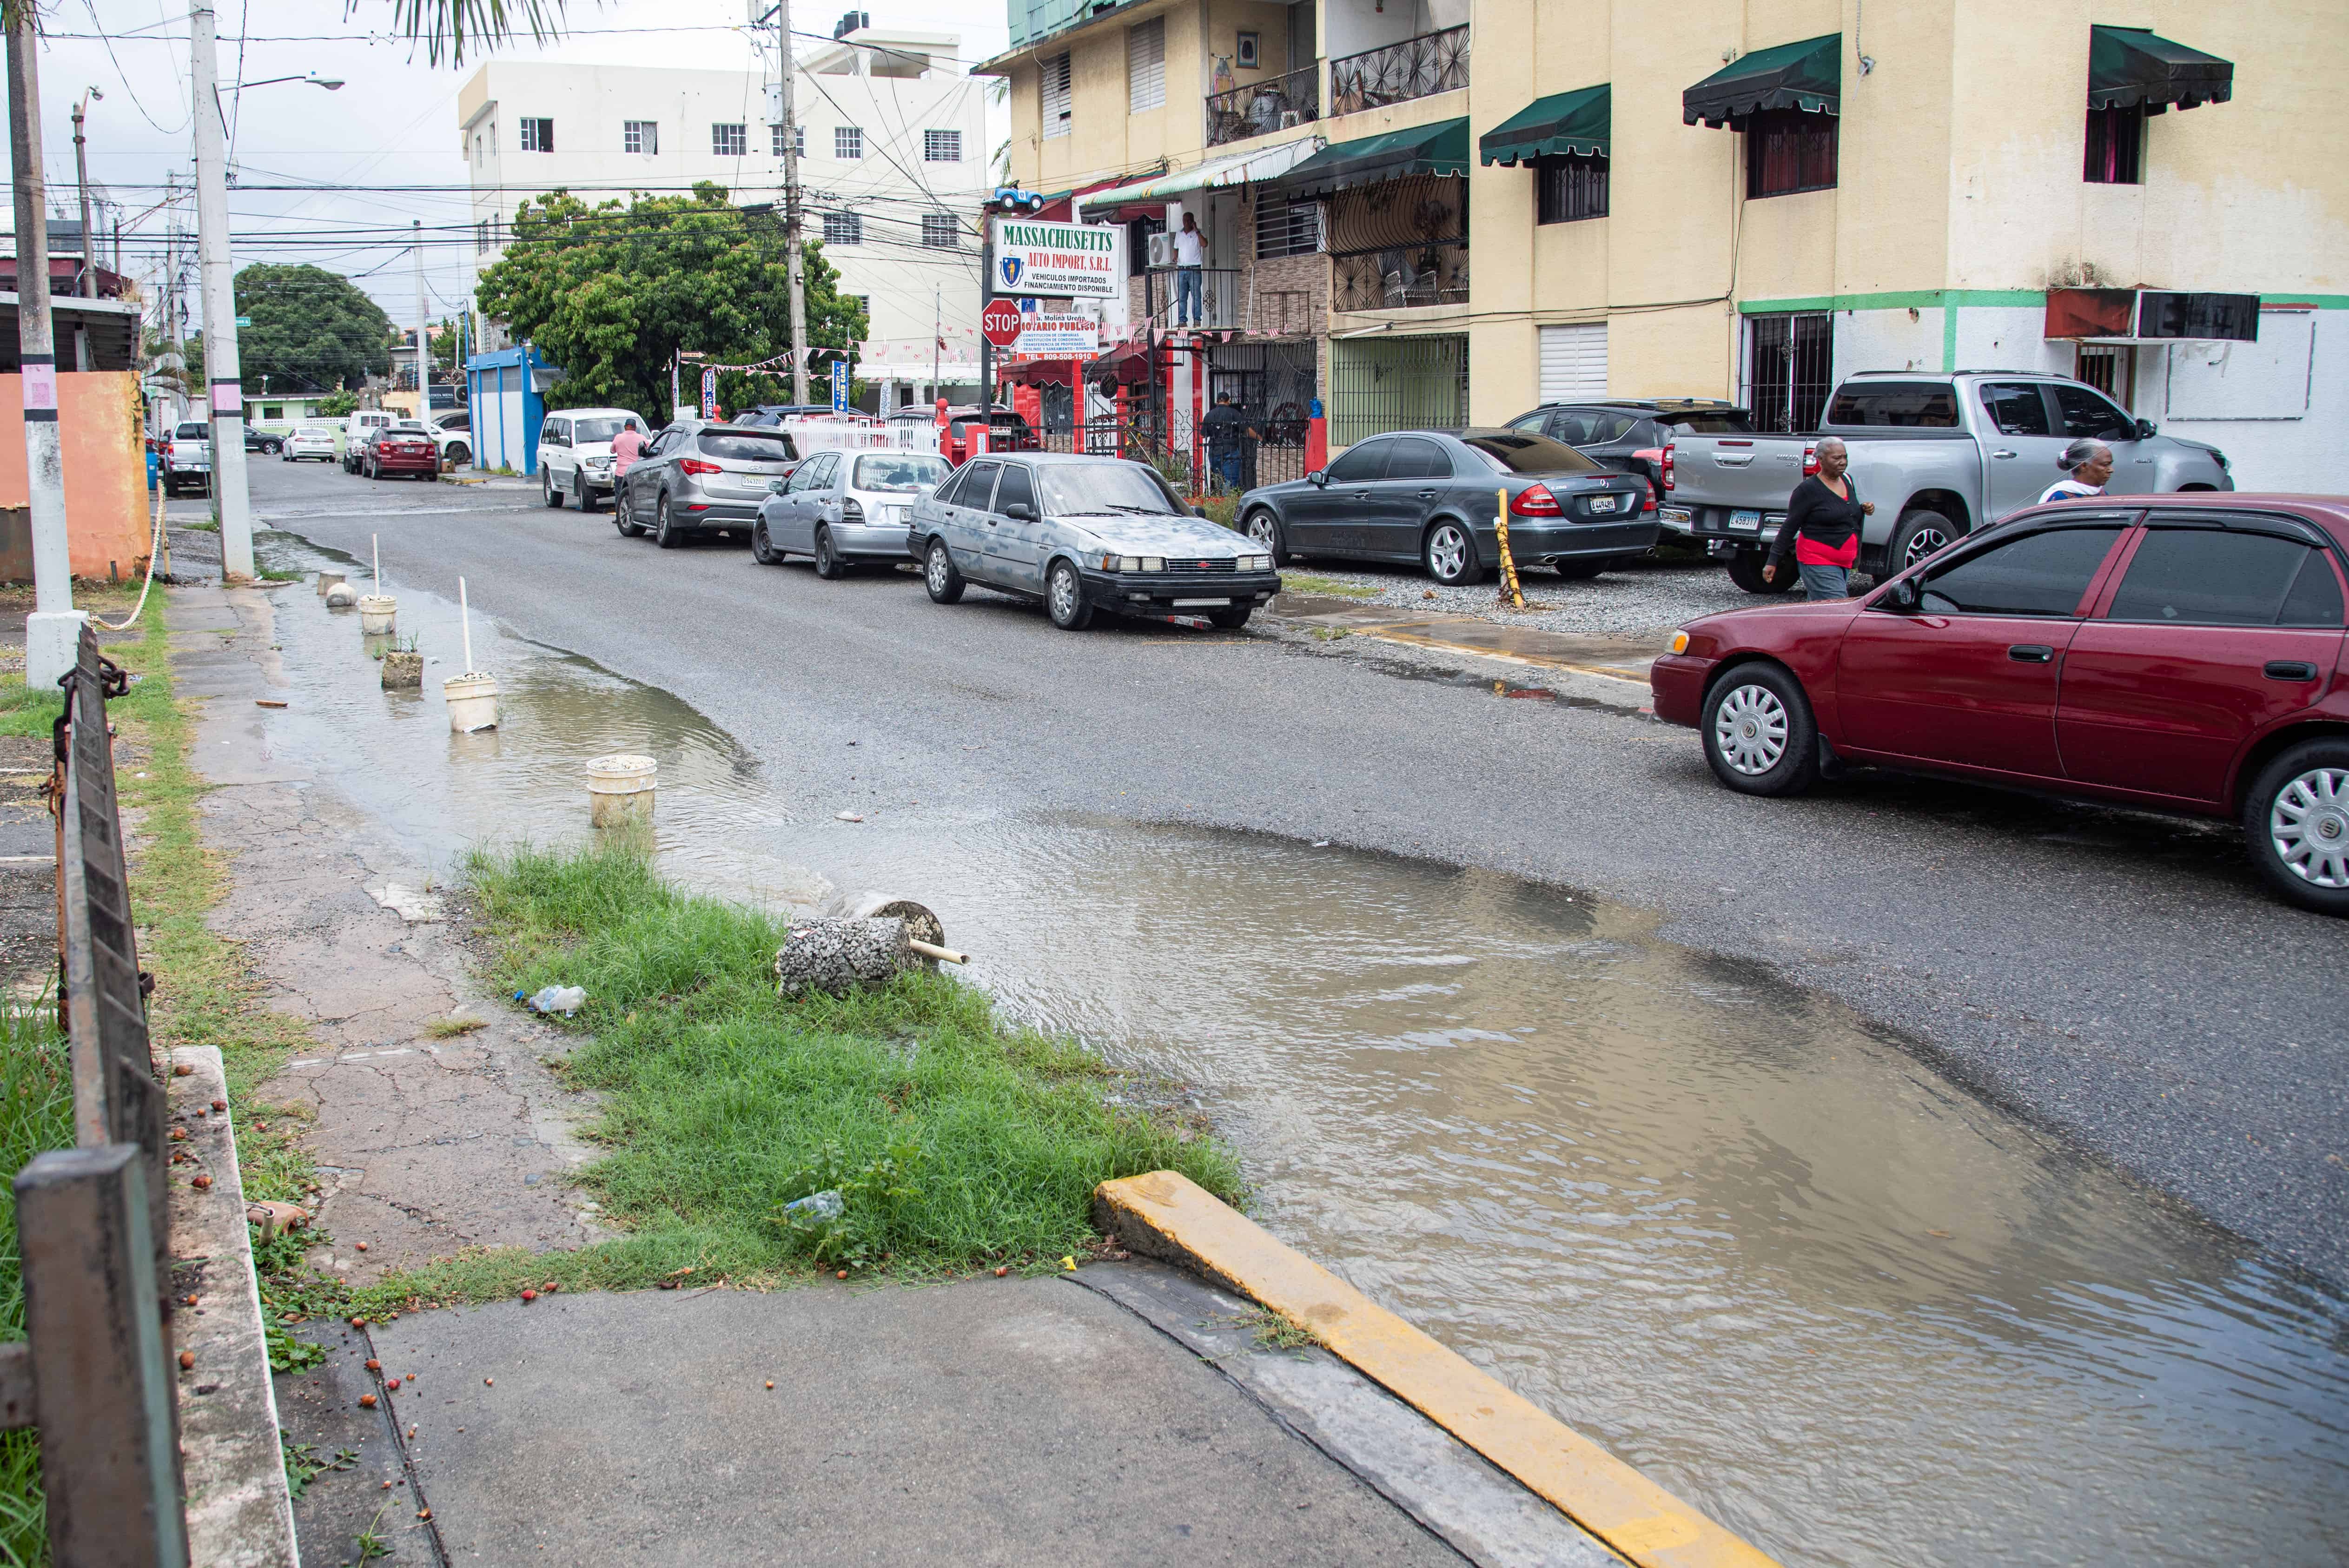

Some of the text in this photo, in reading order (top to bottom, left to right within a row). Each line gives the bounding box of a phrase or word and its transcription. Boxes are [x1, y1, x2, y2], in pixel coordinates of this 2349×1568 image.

[1004, 225, 1112, 251] MASSACHUSETTS
[1028, 252, 1112, 271] AUTO IMPORT, S.R.L.
[1032, 273, 1106, 284] VEHICULOS IMPORTADOS
[1024, 282, 1112, 293] FINANCIAMIENTO DISPONIBLE
[985, 314, 1019, 332] STOP
[1730, 515, 1758, 526] L458317
